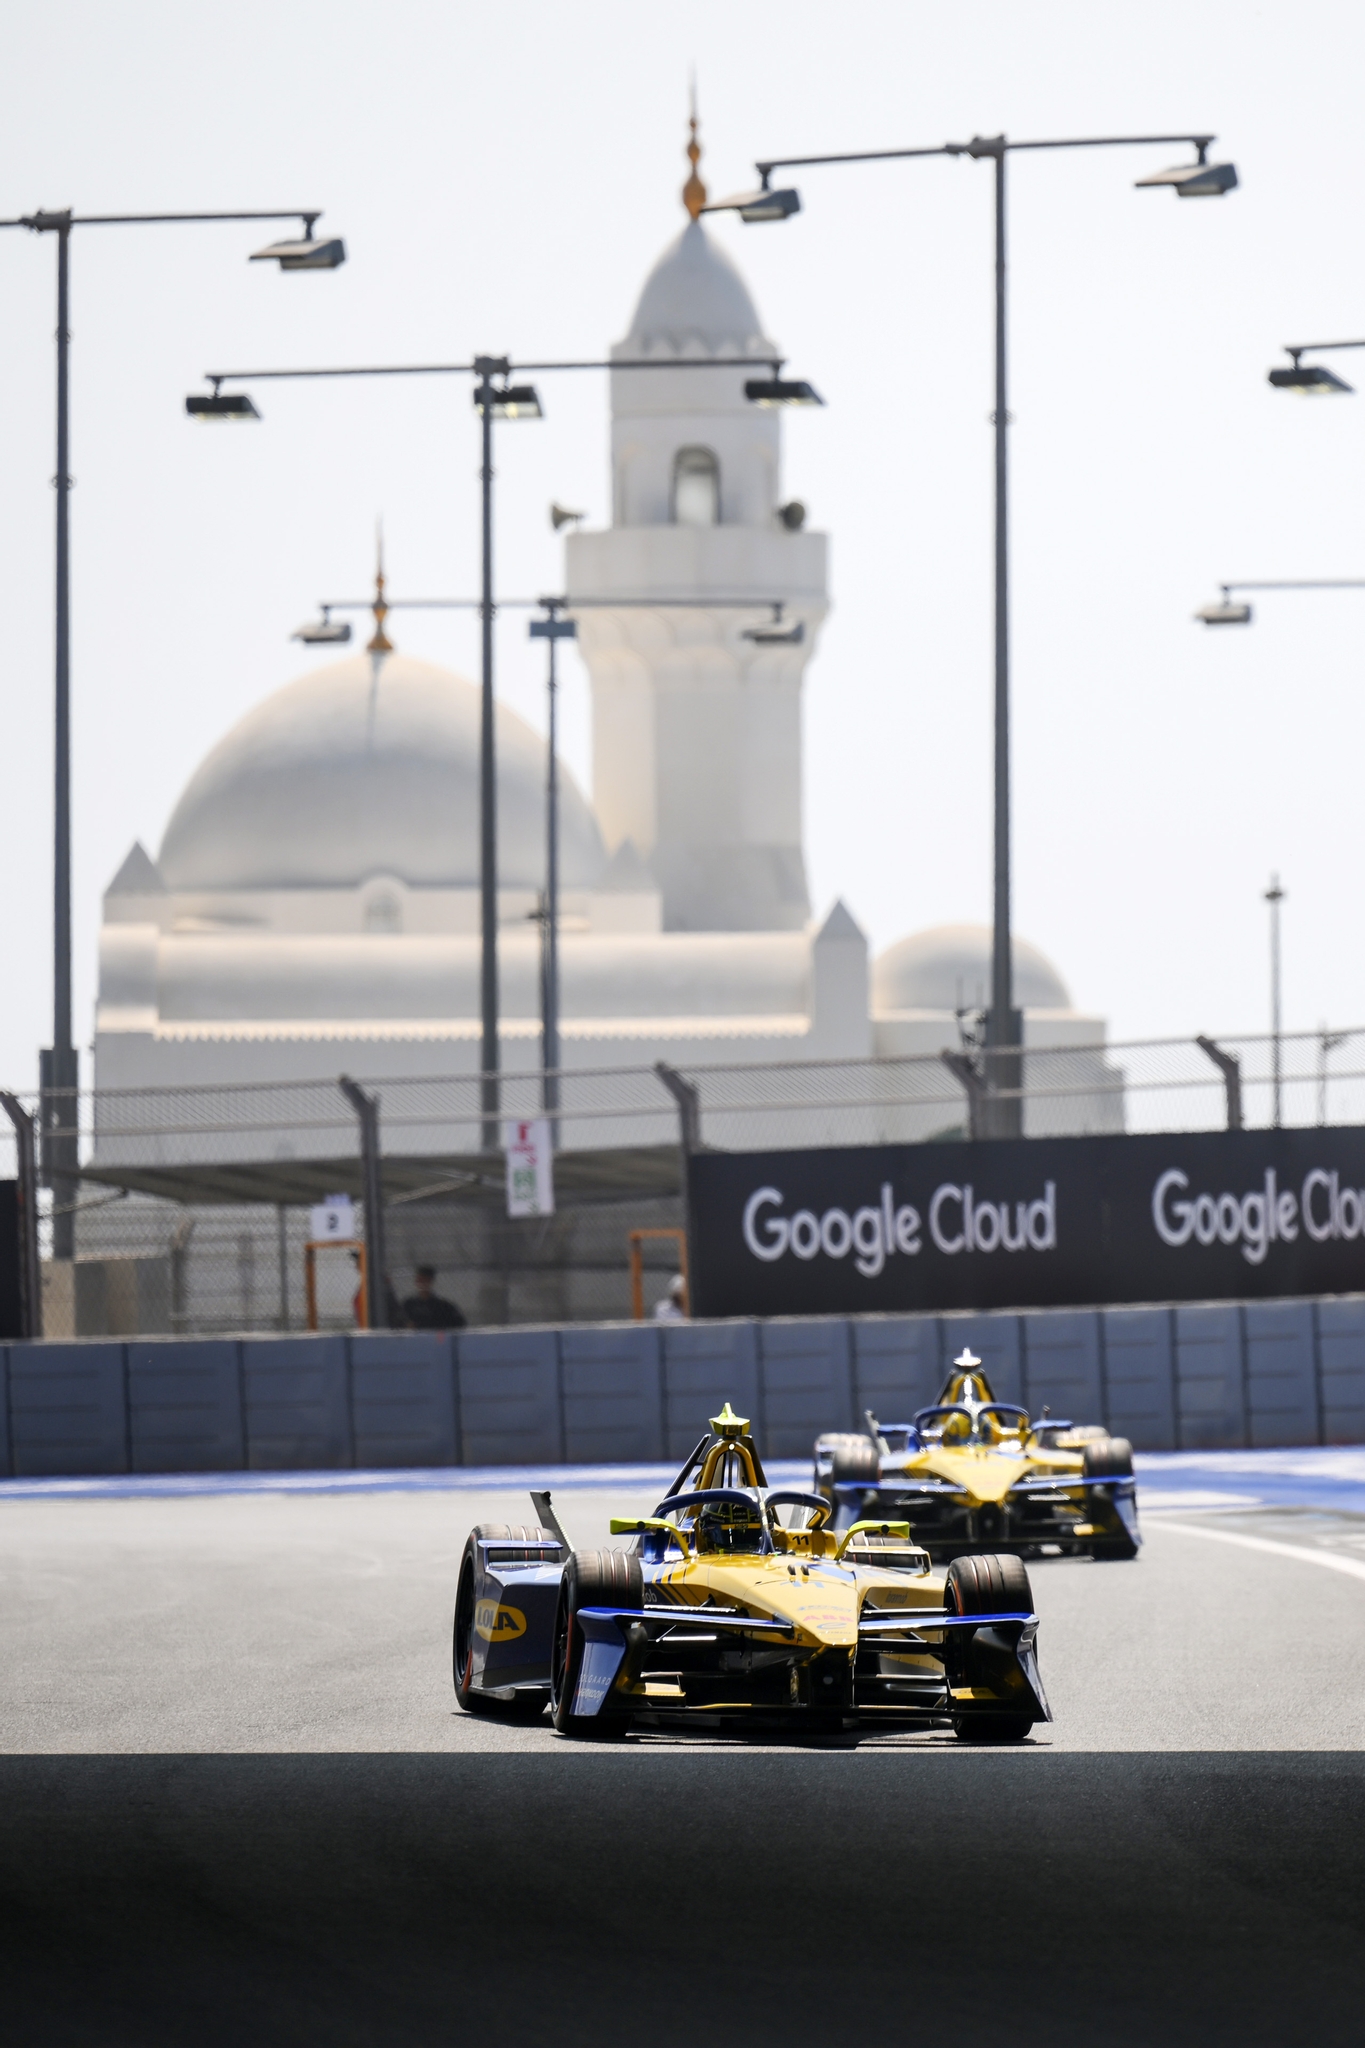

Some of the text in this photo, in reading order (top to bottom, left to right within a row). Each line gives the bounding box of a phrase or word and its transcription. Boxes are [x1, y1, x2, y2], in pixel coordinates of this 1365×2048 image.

[743, 1179, 1056, 1278] Google Cloud
[1152, 1167, 1365, 1266] Google Clo
[792, 1535, 810, 1546] 11
[477, 1606, 521, 1631] LOLA
